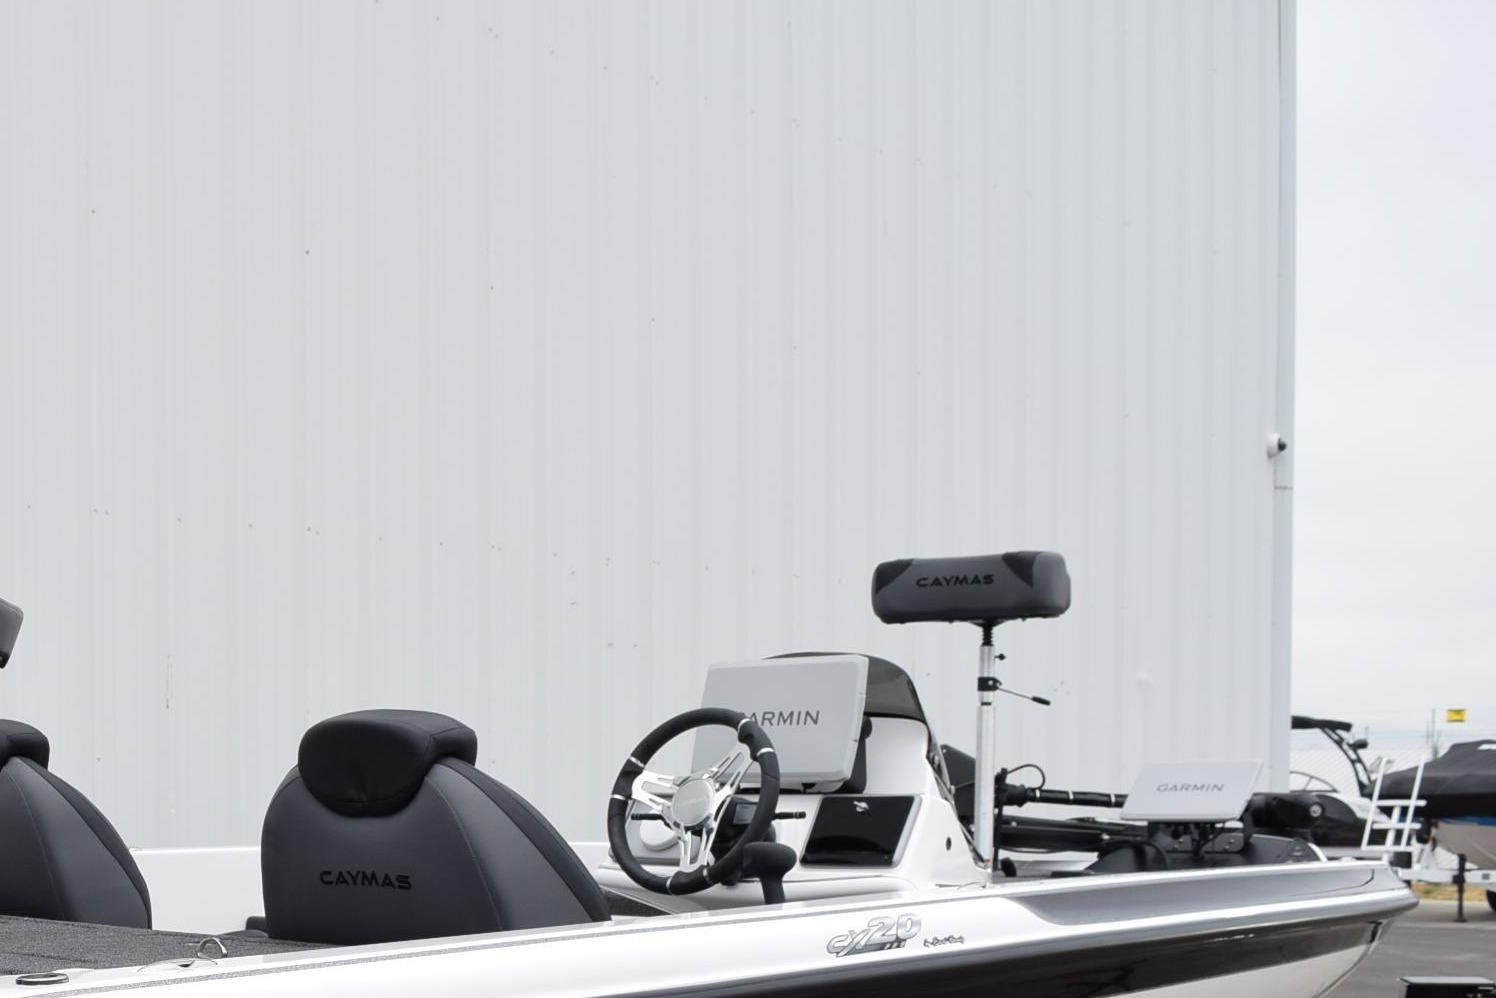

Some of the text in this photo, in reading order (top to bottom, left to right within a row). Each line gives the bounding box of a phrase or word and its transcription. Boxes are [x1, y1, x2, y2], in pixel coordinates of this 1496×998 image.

[916, 574, 994, 587] CAYMAS
[741, 710, 820, 727] ARMIN
[1156, 783, 1225, 793] GARMIN
[319, 870, 412, 890] CAYMAS
